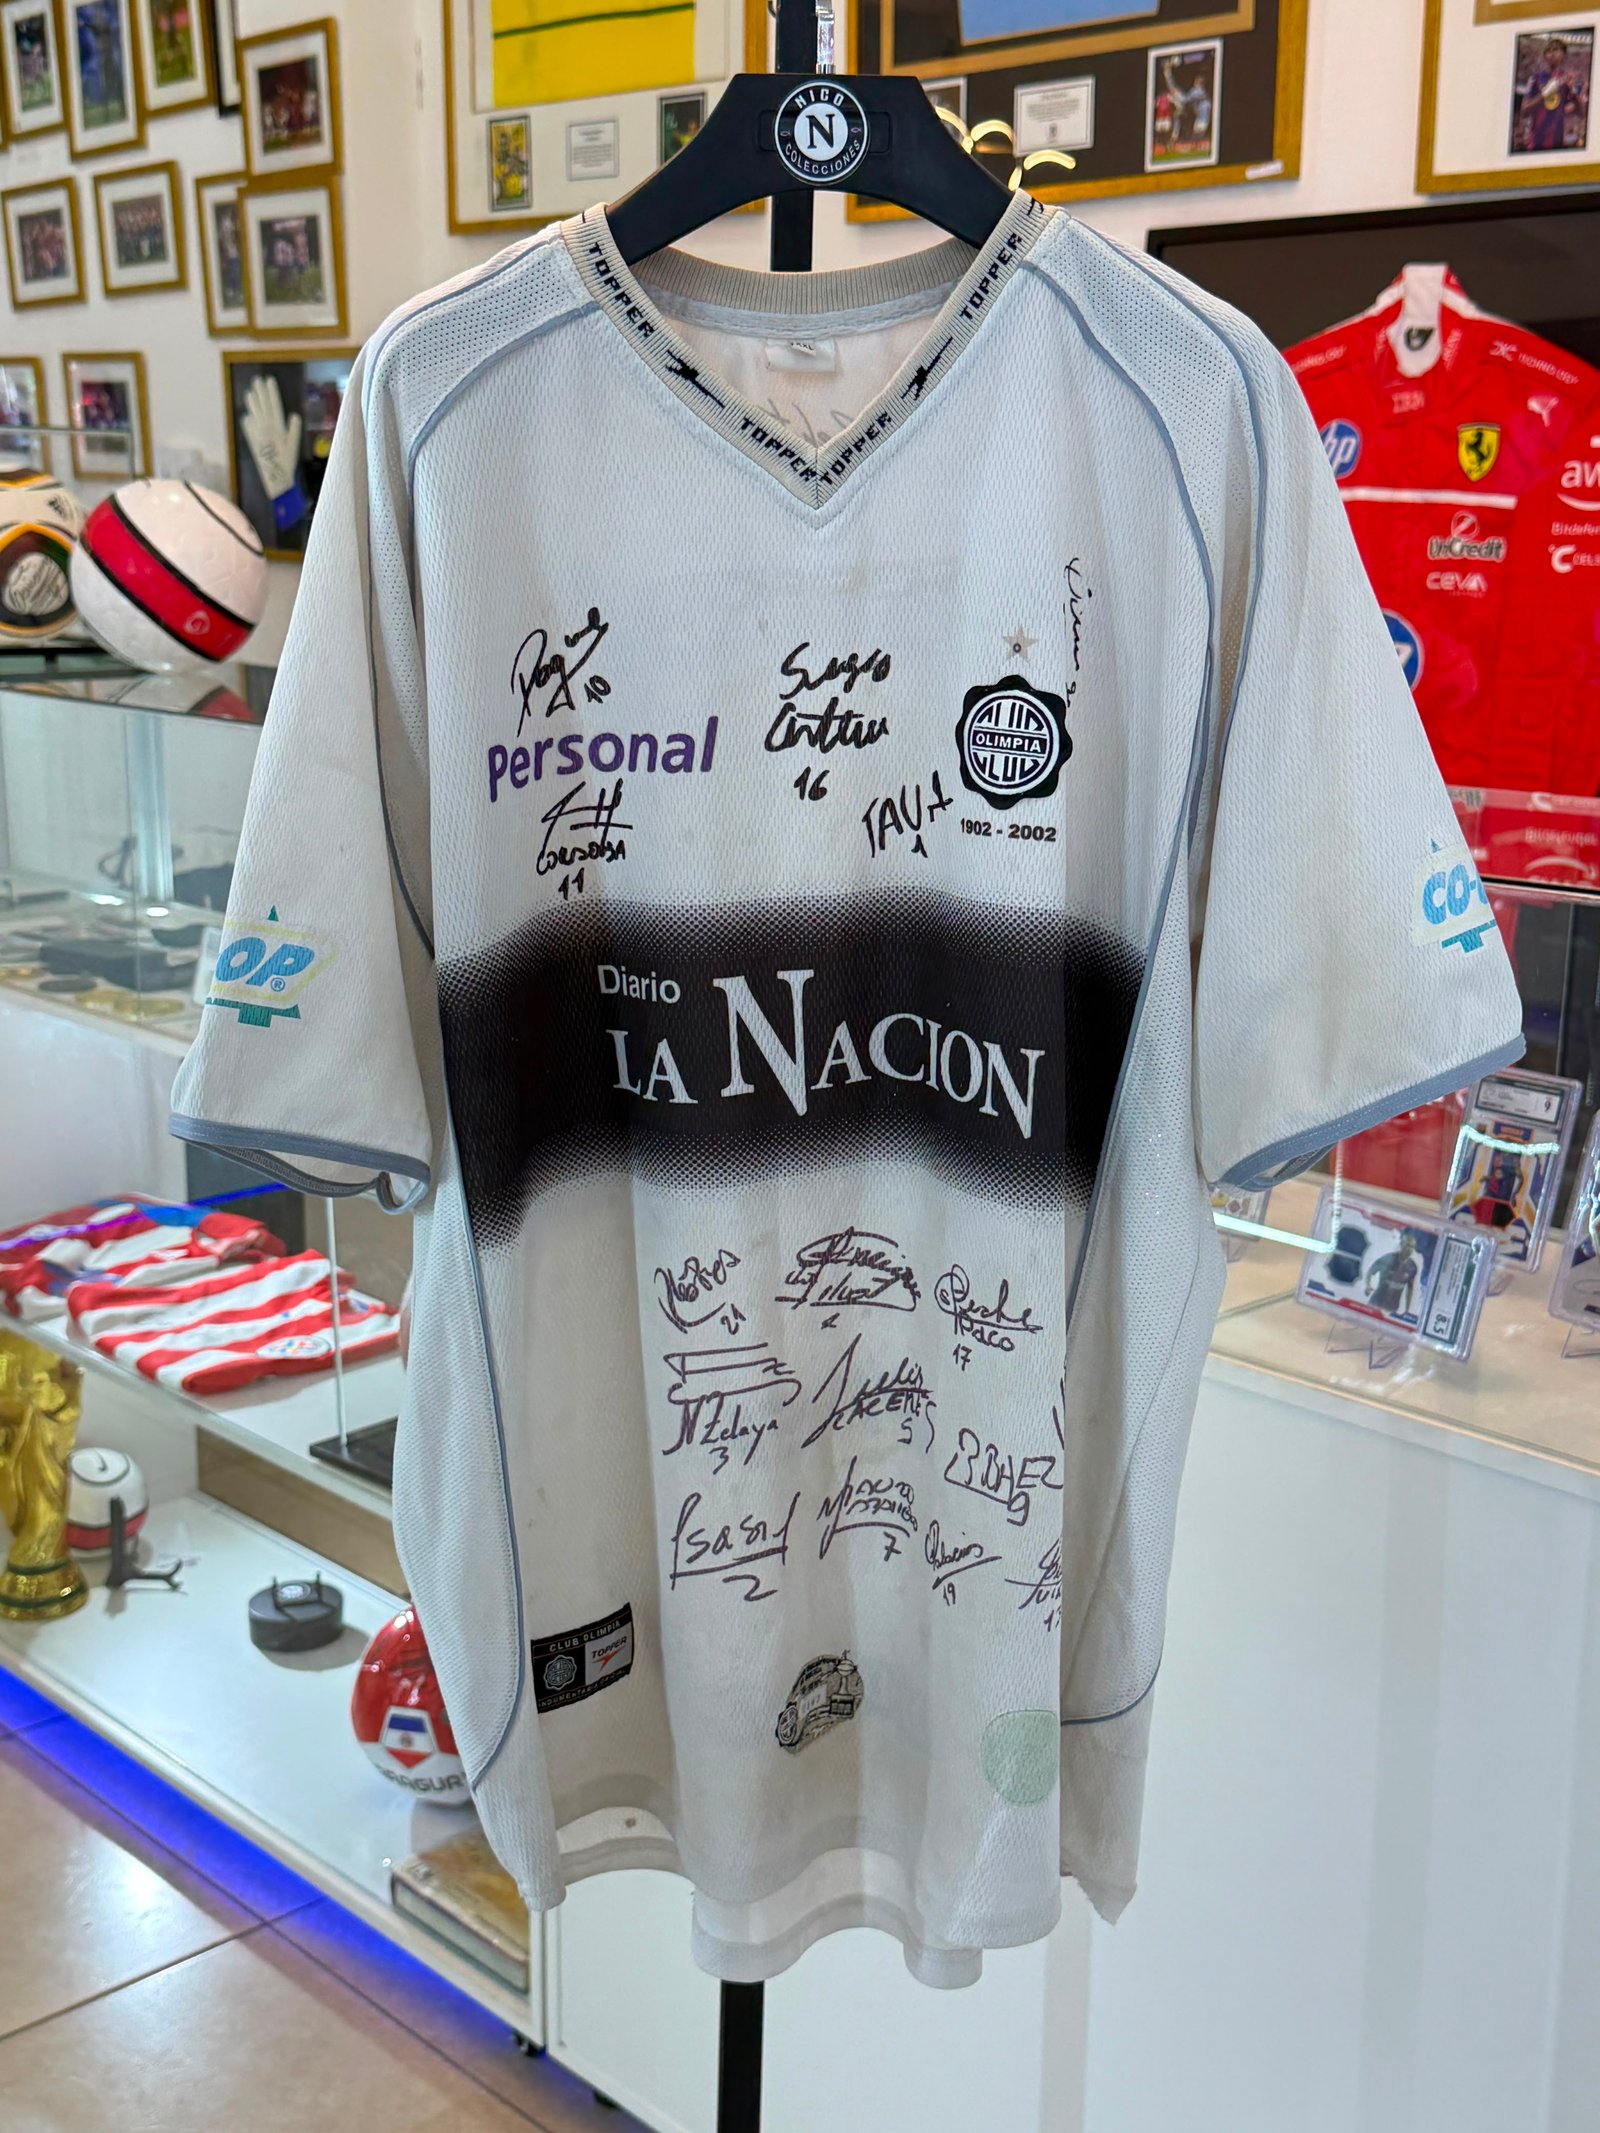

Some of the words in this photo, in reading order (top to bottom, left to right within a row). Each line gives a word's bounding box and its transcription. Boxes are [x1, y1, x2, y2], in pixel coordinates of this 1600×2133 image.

[794, 88, 844, 109] NICO
[805, 113, 836, 149] N
[785, 139, 860, 174] COLECCIONES
[588, 241, 656, 338] TOPPER
[957, 232, 1023, 320] TOPPER
[740, 415, 818, 482] TOPPER
[819, 410, 893, 485] TOPPER
[1323, 421, 1357, 477] hp
[1425, 571, 1488, 592] CEVA
[487, 716, 719, 803] personal
[975, 733, 1042, 753] OLIMPIA
[794, 766, 830, 801] 16
[960, 817, 993, 841] 1902
[1007, 823, 1057, 842] 2002
[558, 867, 585, 901] 11
[597, 964, 682, 1004] Diario
[605, 1028, 699, 1105] LA
[712, 968, 1046, 1140] NACION
[952, 1343, 973, 1372] 17
[708, 1446, 730, 1475] 3
[1006, 1491, 1030, 1526] 9
[883, 1531, 902, 1562] 7
[549, 1637, 580, 1652] CLUB
[583, 1620, 621, 1642] OLIMPIA
[591, 1636, 627, 1659] TOPPER
